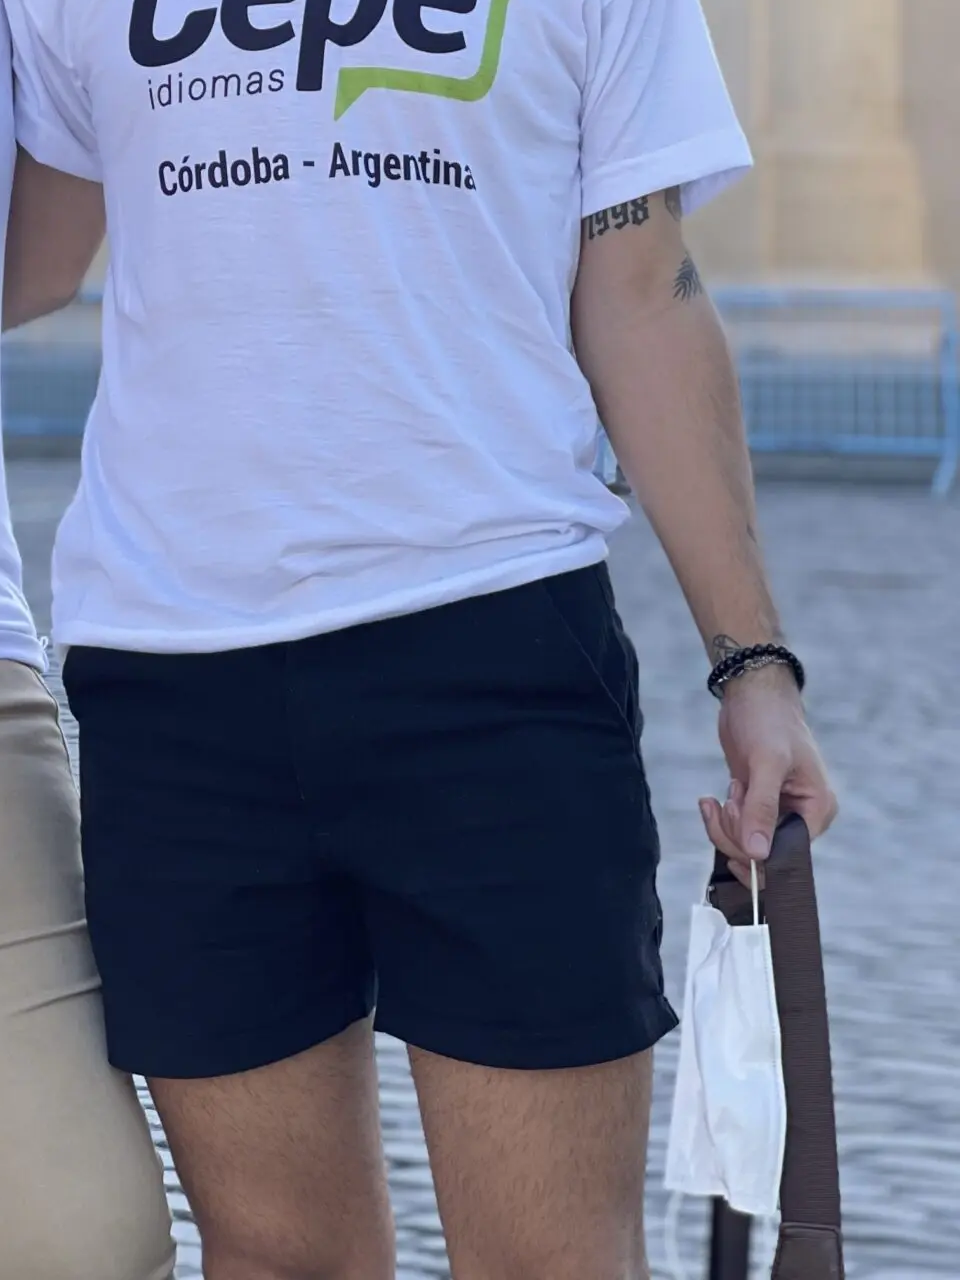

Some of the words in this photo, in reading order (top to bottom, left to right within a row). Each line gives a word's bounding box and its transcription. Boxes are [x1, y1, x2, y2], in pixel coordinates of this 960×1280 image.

[147, 68, 286, 111] idiomas
[158, 146, 290, 196] Córdoba
[328, 142, 477, 191] Argentina
